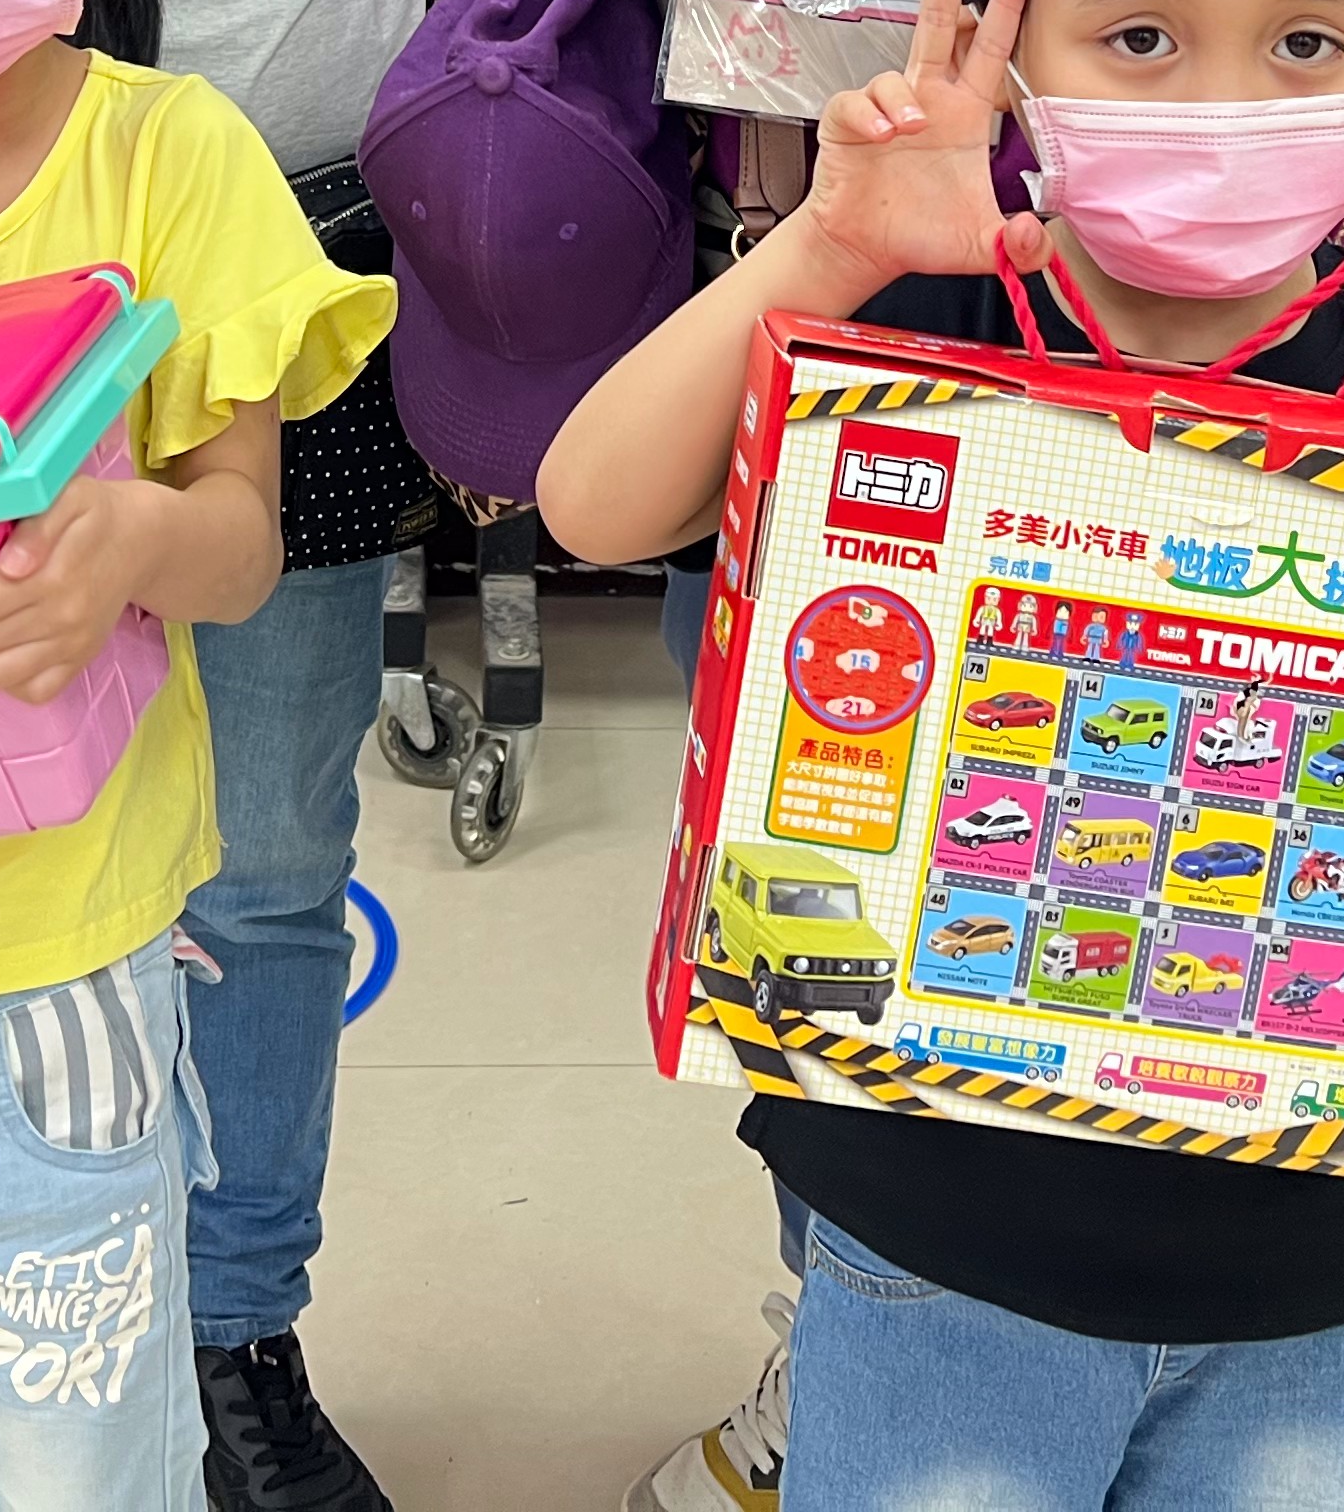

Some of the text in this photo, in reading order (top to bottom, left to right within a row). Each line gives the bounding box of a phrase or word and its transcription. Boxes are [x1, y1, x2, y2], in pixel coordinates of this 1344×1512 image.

[838, 451, 947, 511] トミカ
[982, 508, 1149, 563] 多美小汽車
[823, 533, 938, 574] TOMICA
[987, 555, 1053, 583] 完成圖
[862, 606, 873, 620] 9
[1158, 623, 1188, 641] トミカ
[850, 653, 871, 671] 15
[1146, 649, 1192, 666] TOMICA
[969, 662, 984, 675] 78
[1086, 681, 1098, 692] 14
[842, 700, 863, 717] 21
[1065, 797, 1081, 808] 49
[1182, 814, 1191, 825] 6
[1012, 867, 1028, 877] CAR
[930, 894, 946, 905] 48
